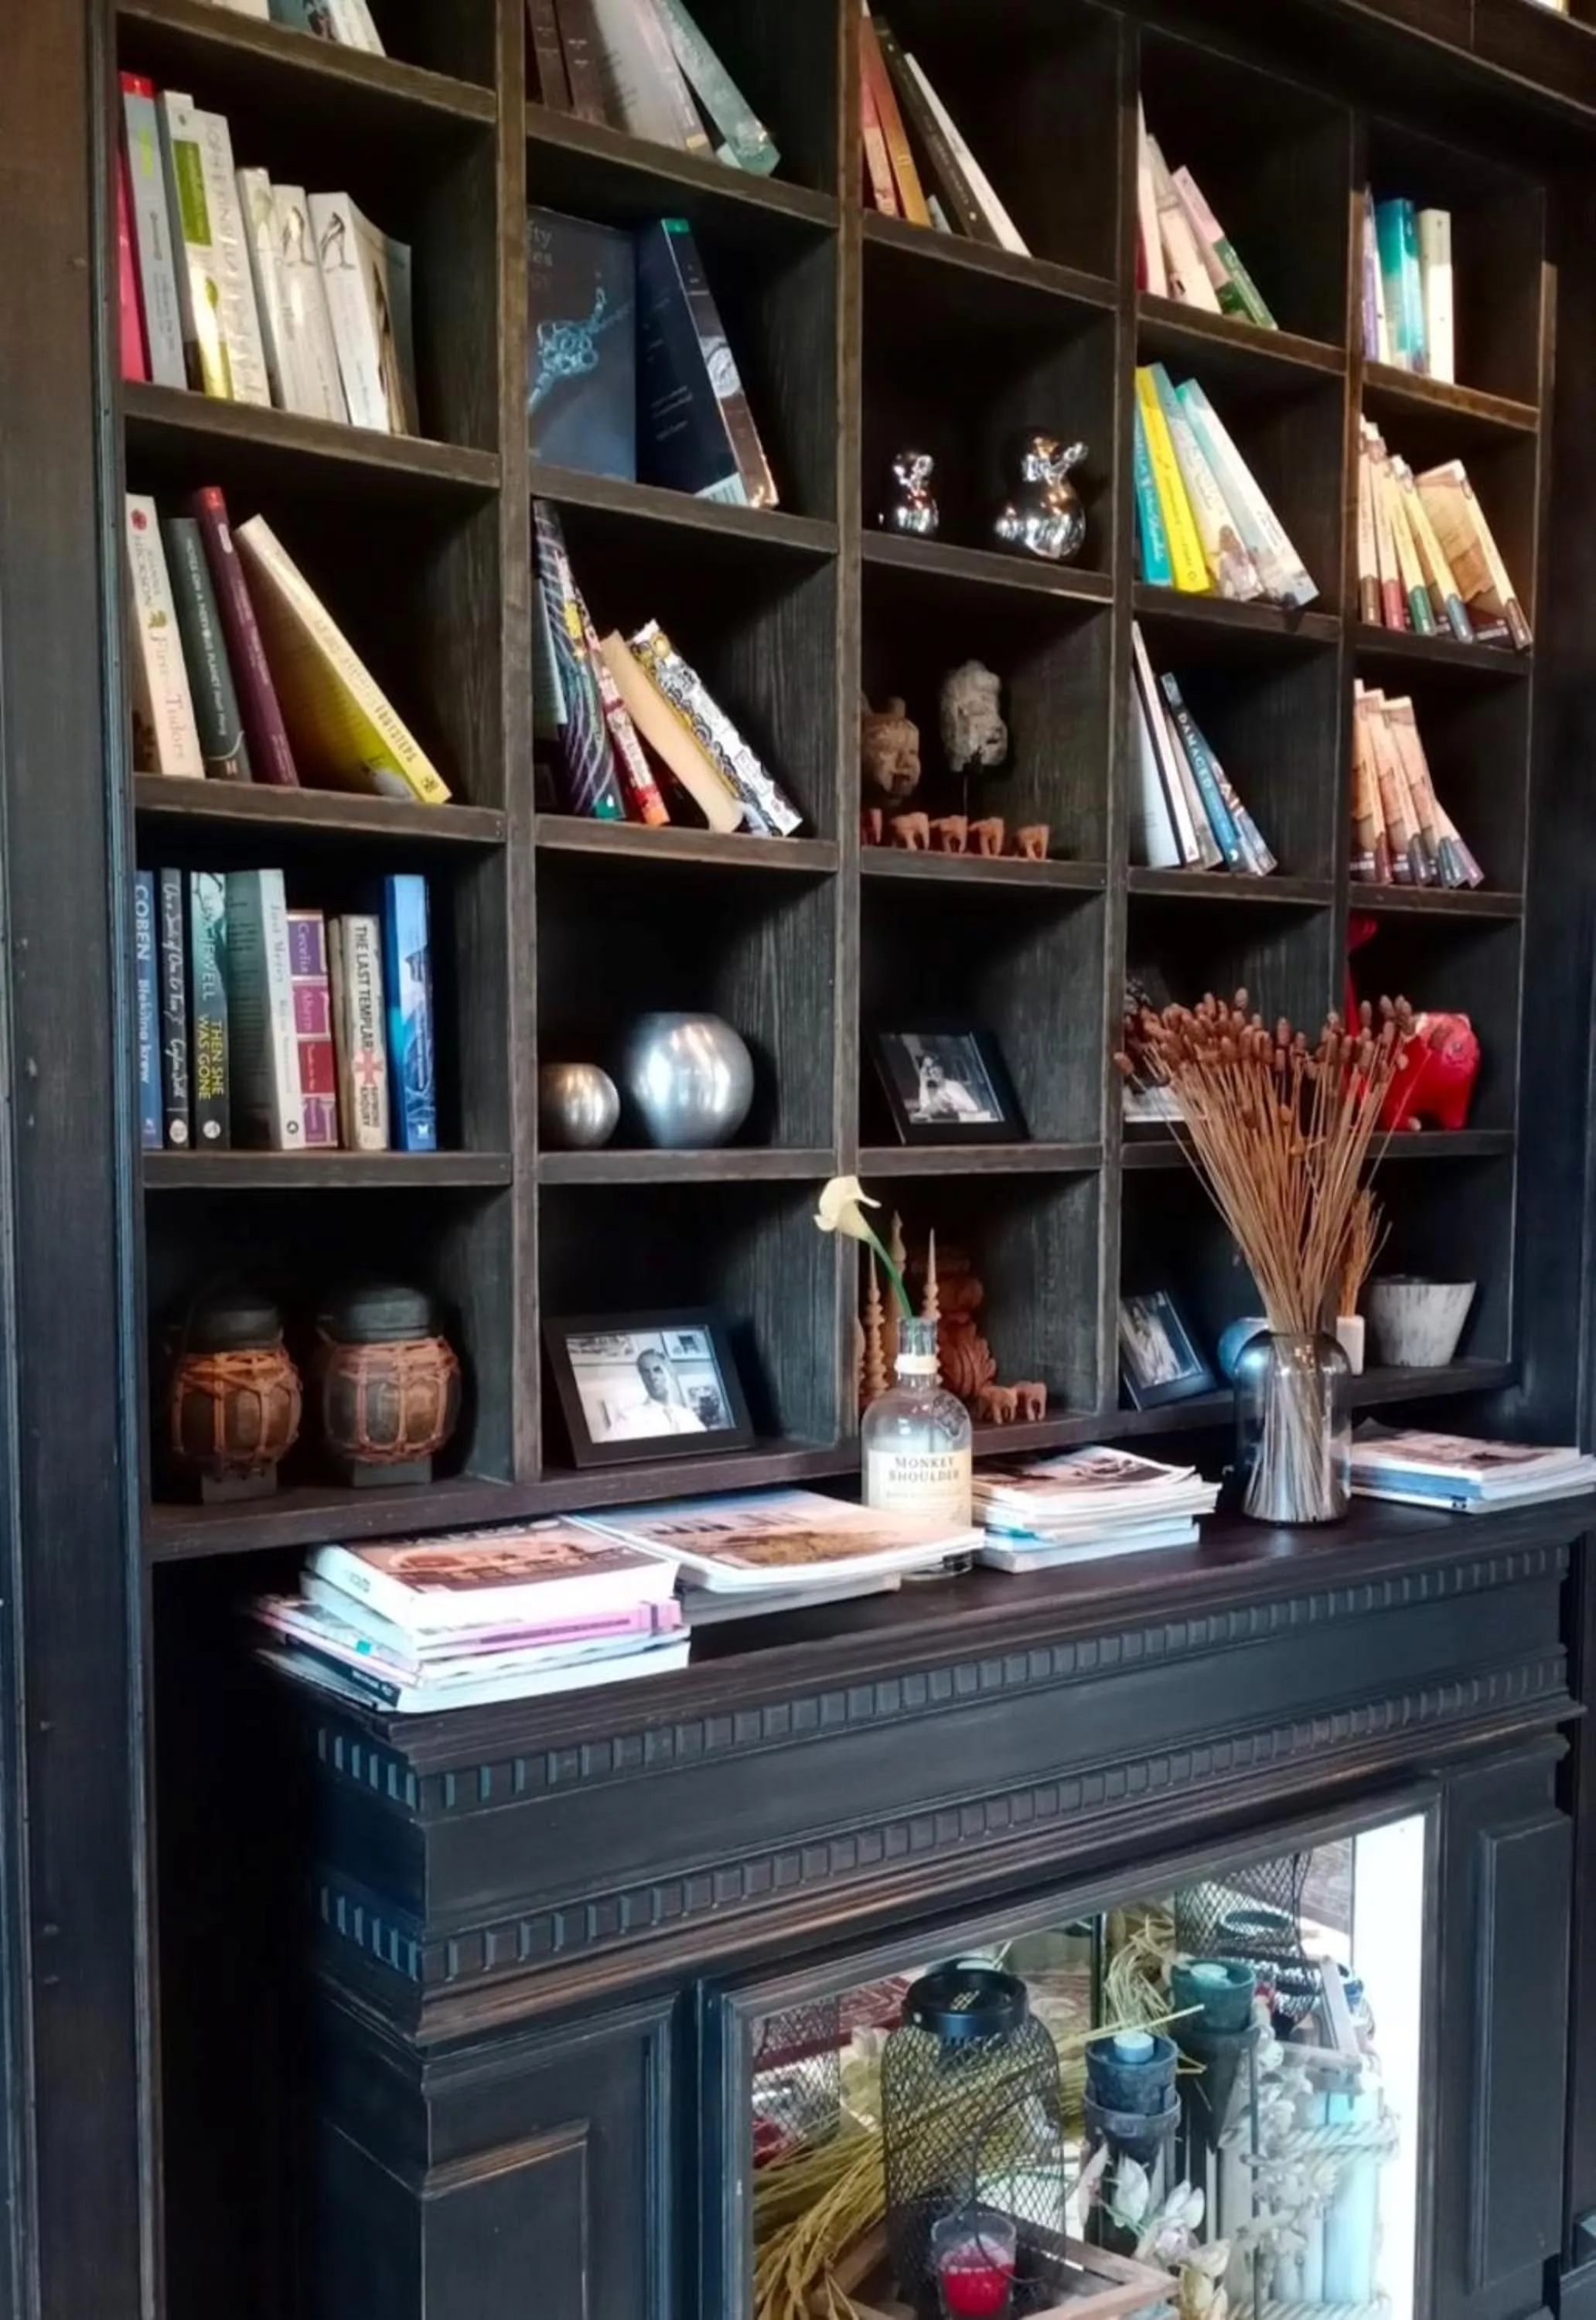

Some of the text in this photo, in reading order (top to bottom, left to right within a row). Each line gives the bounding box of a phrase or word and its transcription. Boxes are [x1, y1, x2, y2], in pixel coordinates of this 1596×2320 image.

[1176, 711, 1214, 789] DAMAGED
[135, 885, 151, 960] COBEN
[296, 922, 312, 973] Cecelia
[300, 990, 318, 1029] Ahern
[355, 926, 374, 1048] THE LAST TEMPLAR
[197, 1014, 210, 1100] WAS GONE
[210, 1020, 223, 1095] THEN SHE
[888, 1469, 960, 1482] SHOULDER
[895, 1456, 956, 1469] MONKEY
